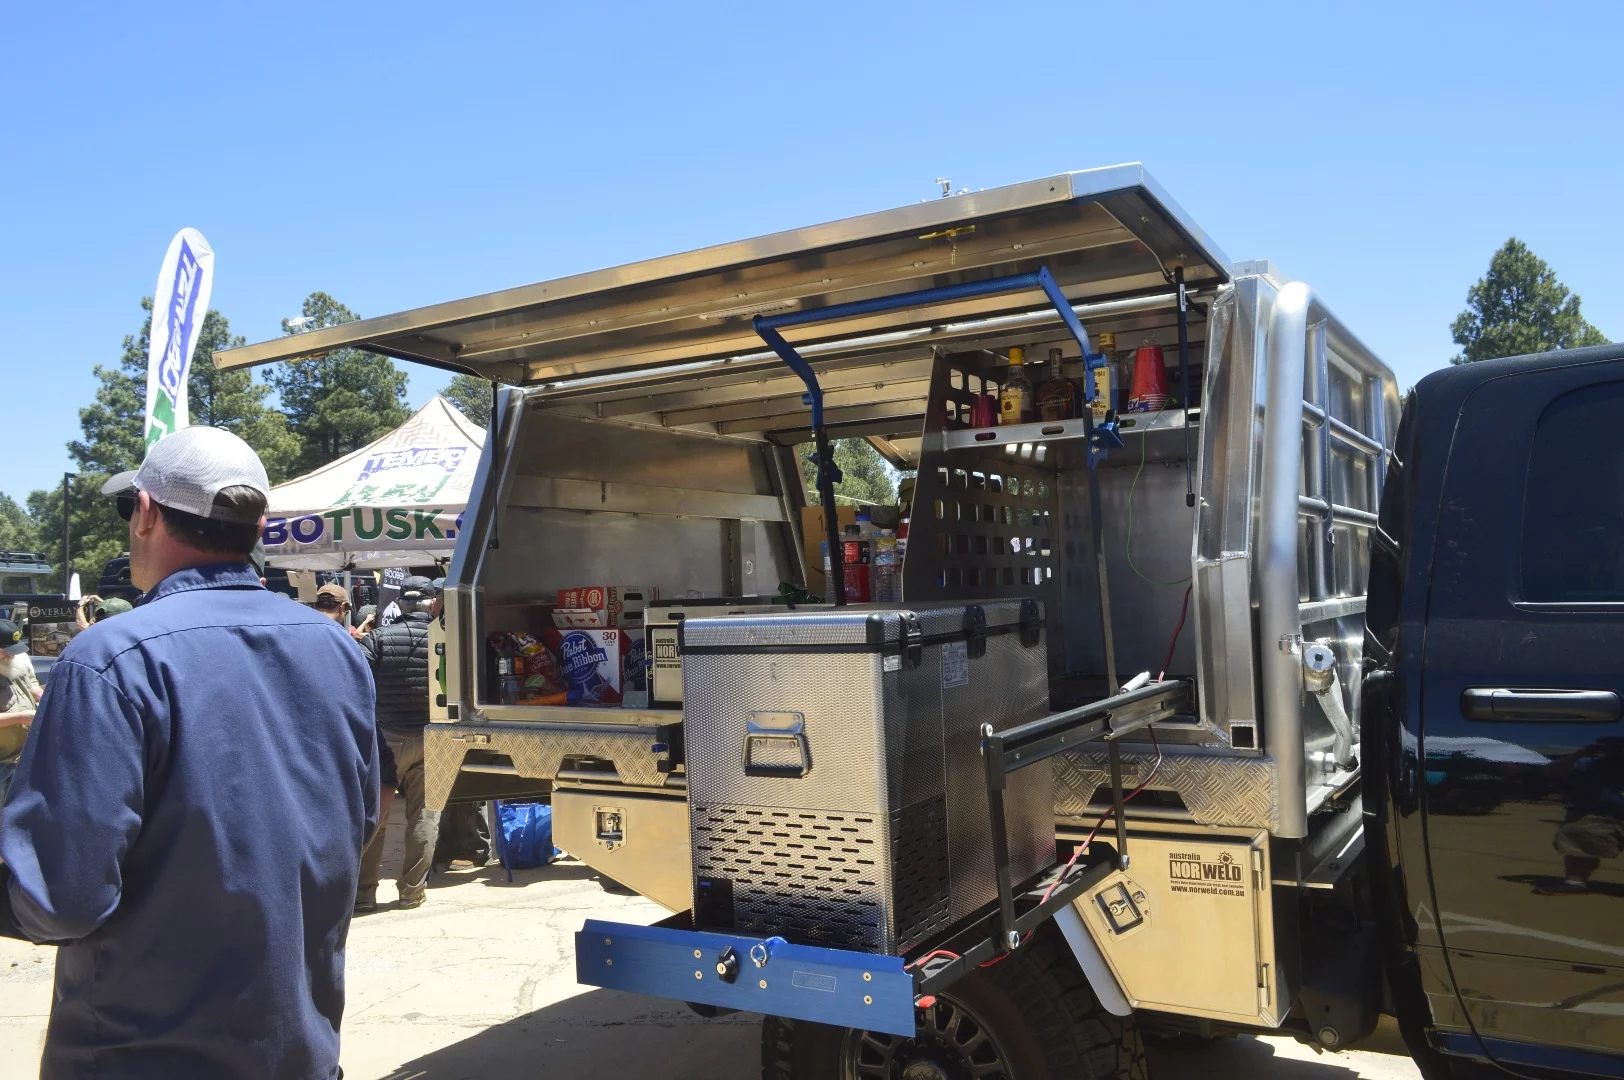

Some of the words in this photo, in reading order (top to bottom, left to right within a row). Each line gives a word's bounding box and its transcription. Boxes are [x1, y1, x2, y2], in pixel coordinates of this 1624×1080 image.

[263, 507, 465, 545] BOTUSK.
[602, 632, 617, 641] 30
[560, 638, 587, 660] Pabst
[557, 663, 574, 677] lue
[572, 651, 606, 669] Ribbon
[1169, 852, 1201, 861] australia
[1171, 862, 1242, 881] NORWELD
[1171, 885, 1245, 897] www.norweld.com.au
